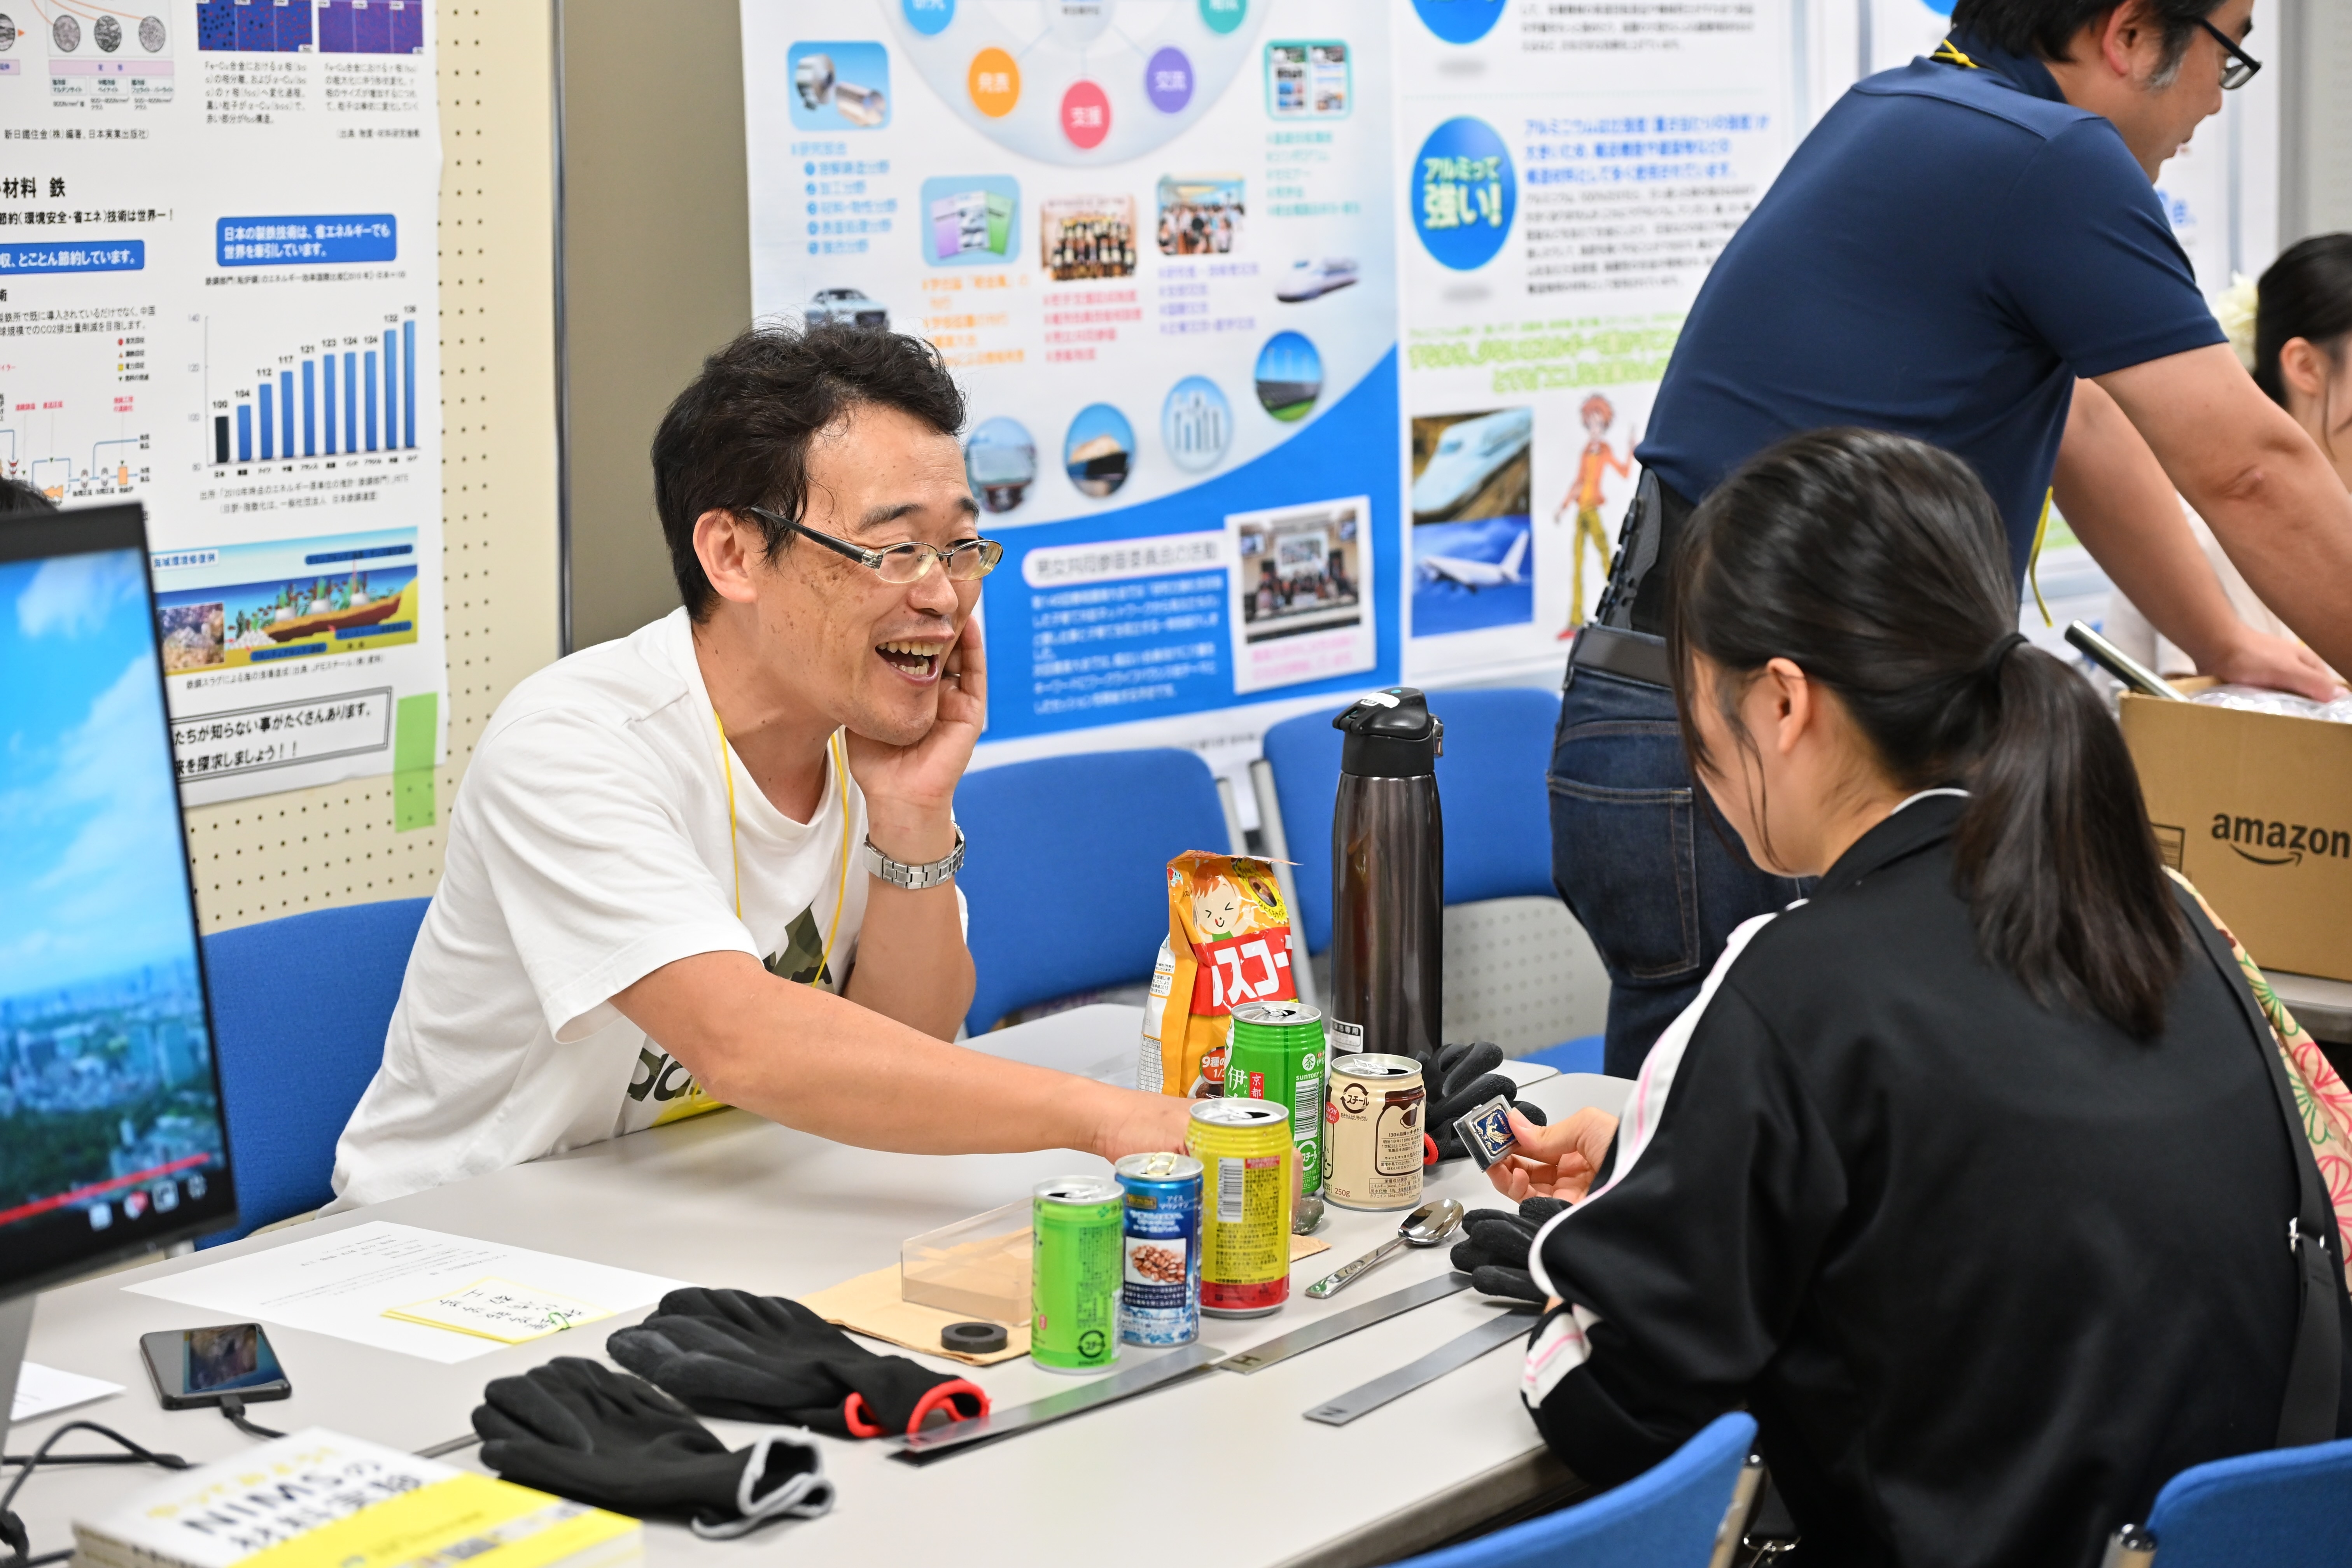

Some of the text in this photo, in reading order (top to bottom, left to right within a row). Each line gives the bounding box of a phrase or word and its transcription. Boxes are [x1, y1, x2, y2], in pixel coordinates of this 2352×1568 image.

[1071, 107, 1102, 128] 支援
[1424, 156, 1500, 183] アルミって
[0, 177, 65, 198] 材料 鉄
[1424, 182, 1502, 229] 強い!
[279, 356, 294, 364] 117
[257, 368, 272, 377] 112
[213, 401, 228, 409] 100
[2211, 812, 2351, 859] amazon
[1304, 1055, 1314, 1069] 茶
[1296, 1071, 1320, 1082] SUNTORY
[1251, 1074, 1262, 1099] 京都
[1347, 1094, 1369, 1106] スチール
[1341, 1113, 1368, 1122] あきかんはリサイクル
[1335, 1187, 1351, 1198] 250g
